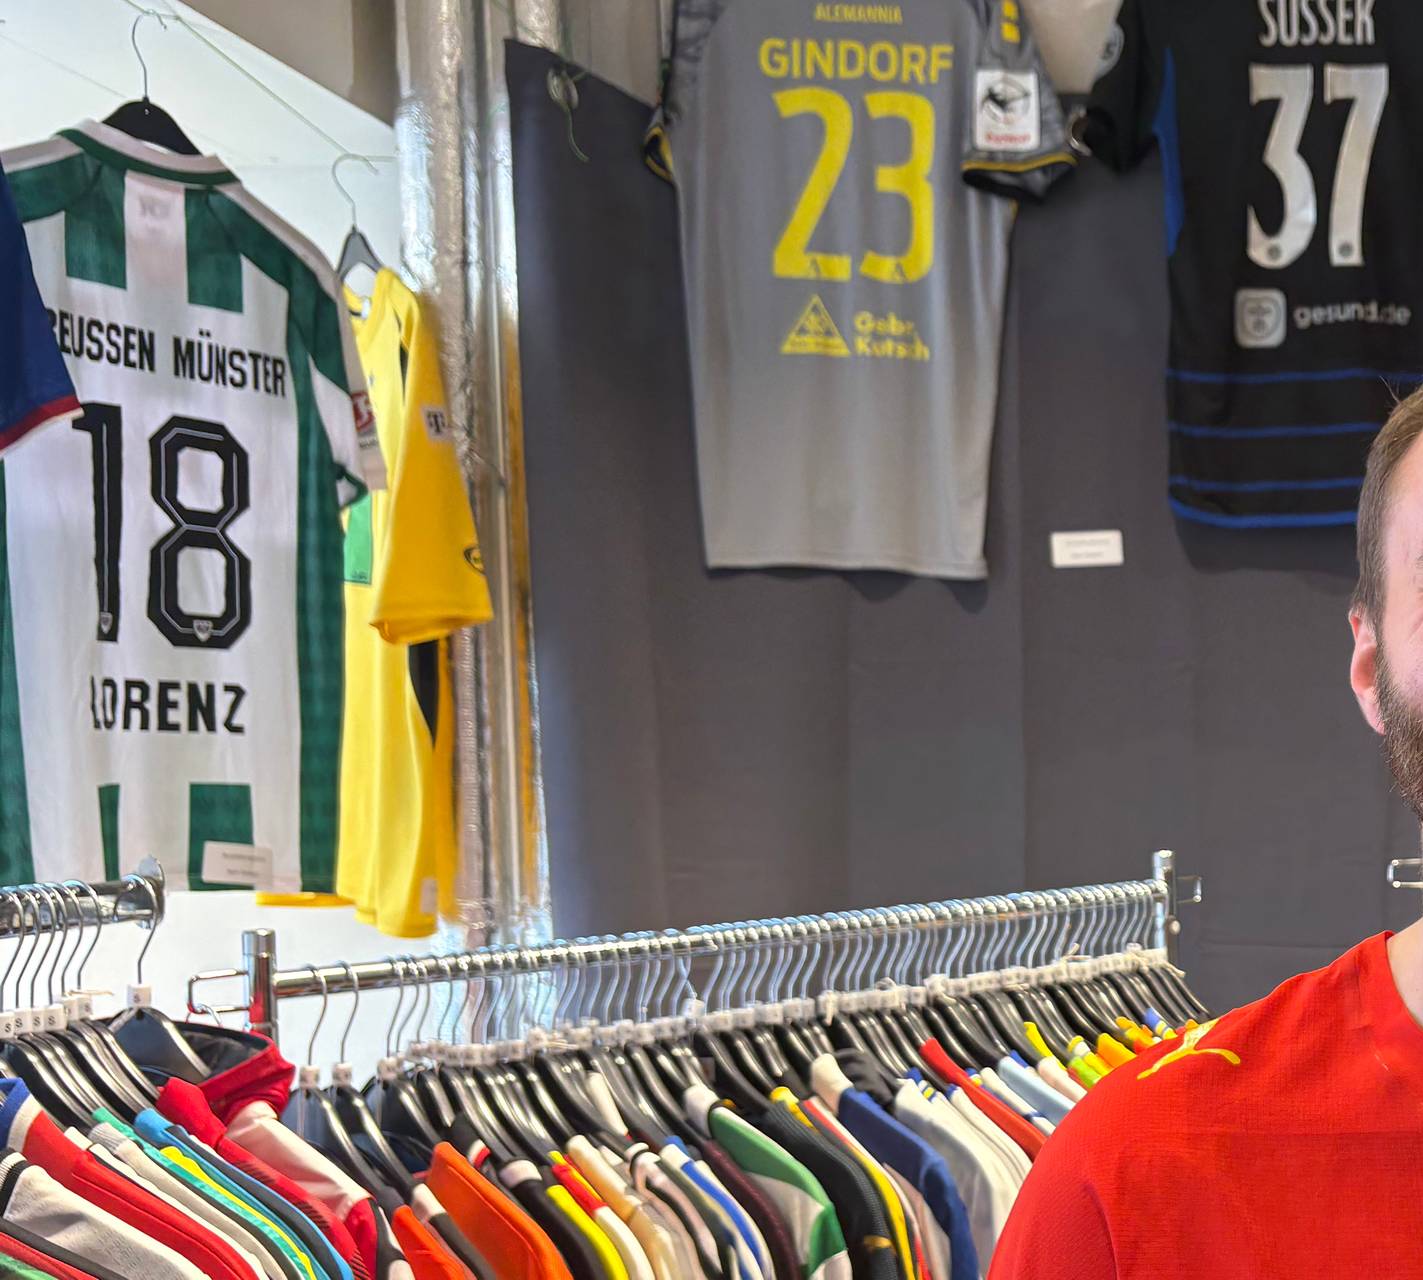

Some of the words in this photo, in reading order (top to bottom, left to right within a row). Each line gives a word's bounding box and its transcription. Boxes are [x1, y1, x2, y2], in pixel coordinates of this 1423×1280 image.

[815, 3, 903, 25] ALEMANNIA
[758, 37, 955, 84] GINDORF
[771, 86, 936, 284] 23
[1246, 62, 1389, 269] 37
[1293, 299, 1411, 330] gesund.de
[172, 328, 287, 398] MÜNSTER
[72, 402, 252, 650] 18
